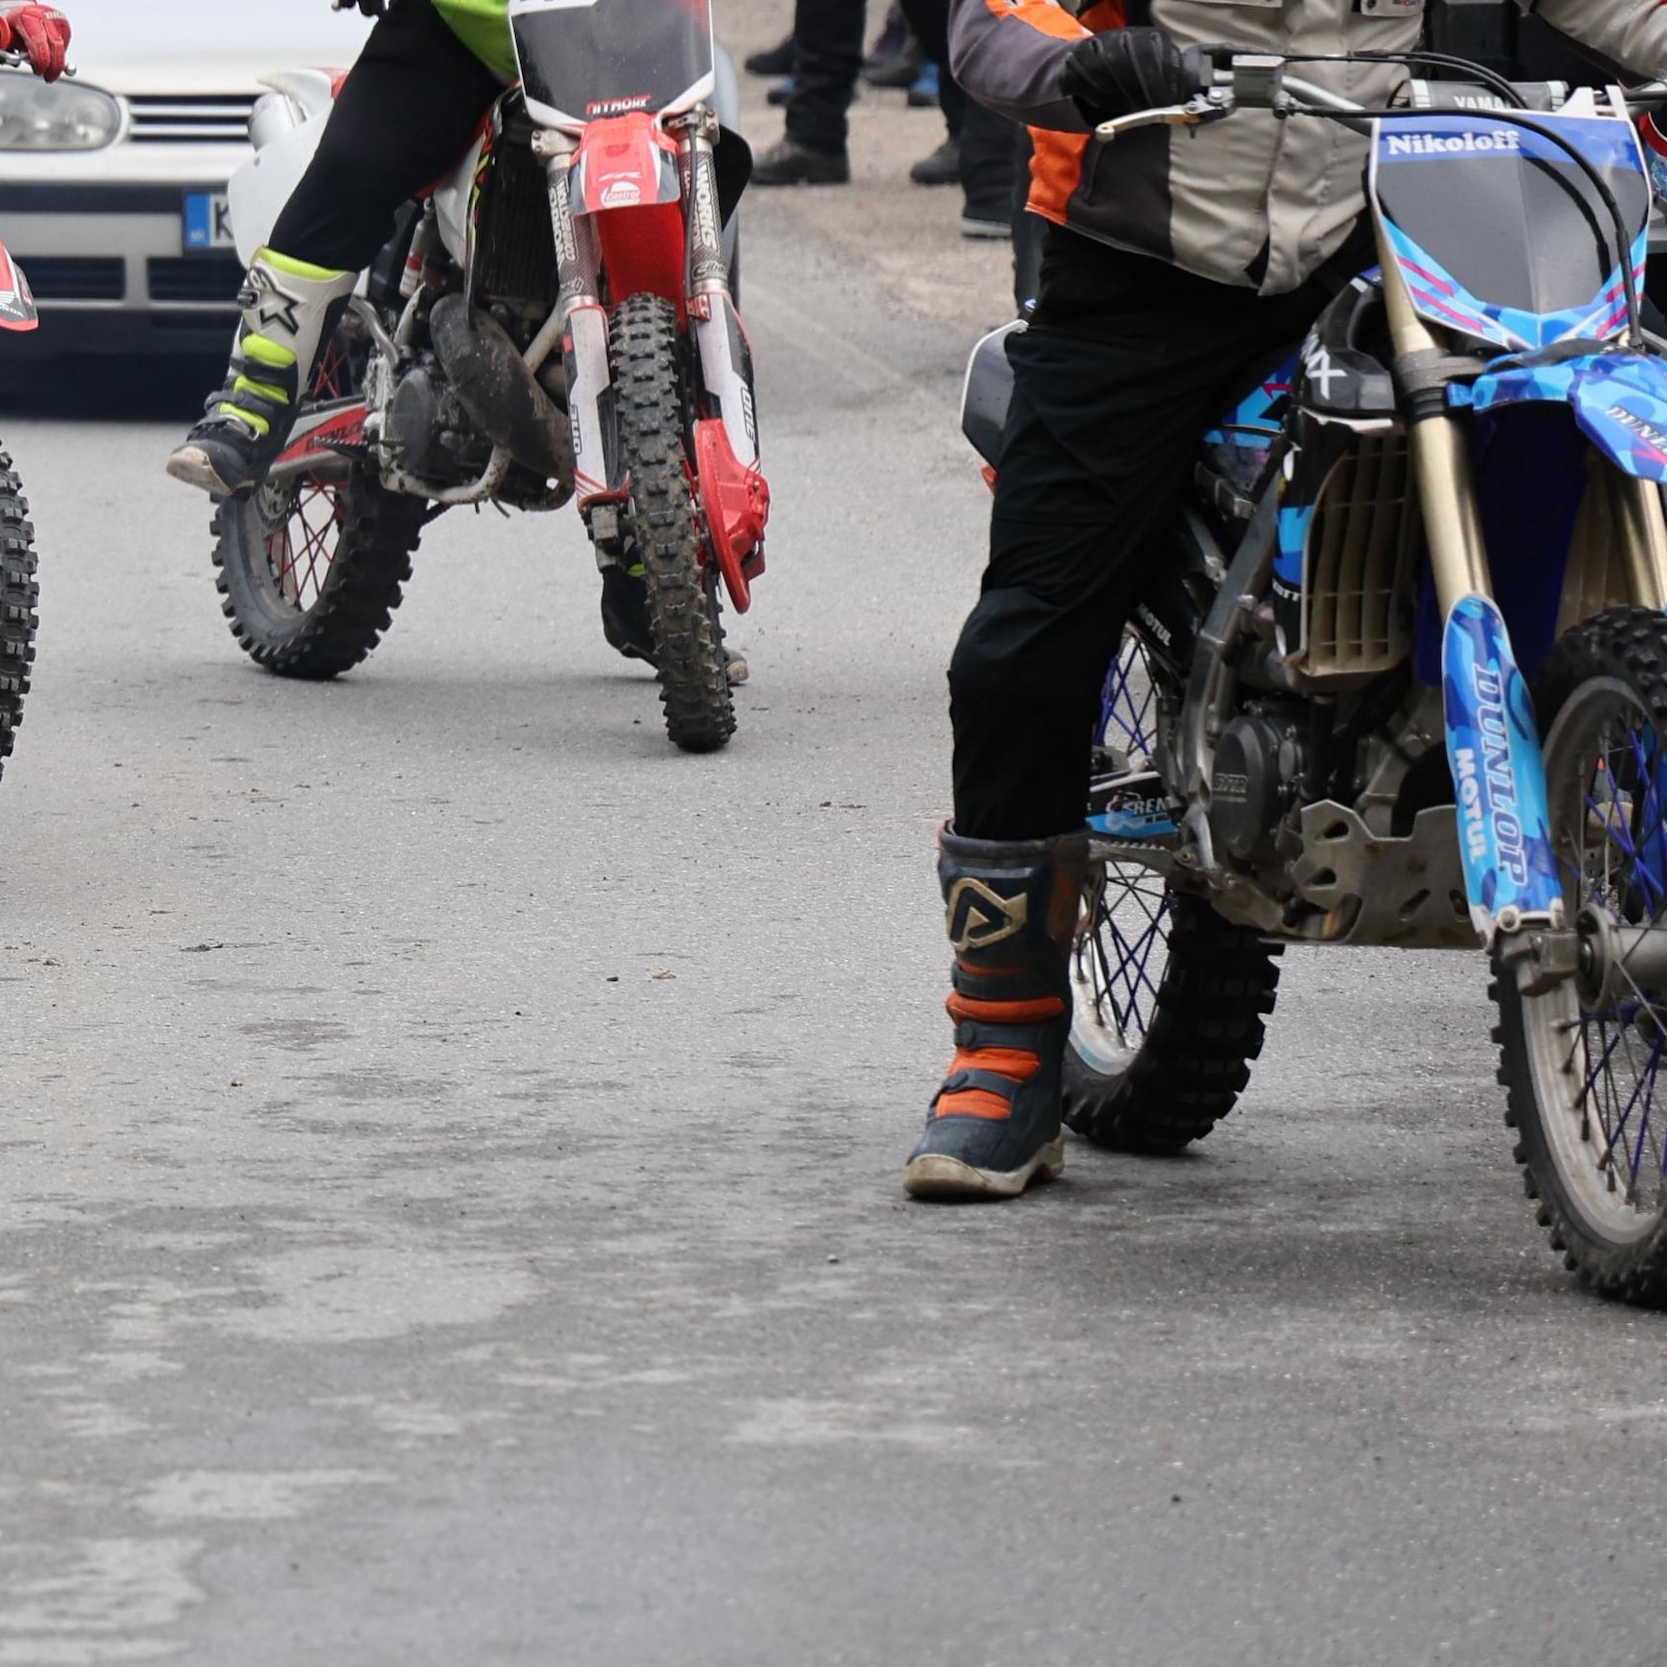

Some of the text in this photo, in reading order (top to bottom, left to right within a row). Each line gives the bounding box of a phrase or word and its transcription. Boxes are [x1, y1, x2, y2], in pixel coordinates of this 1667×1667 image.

[1453, 95, 1513, 110] YAMA
[1386, 130, 1520, 156] Nikoloff
[1454, 748, 1487, 865] MOTUL
[1472, 664, 1529, 886] DUNLOP
